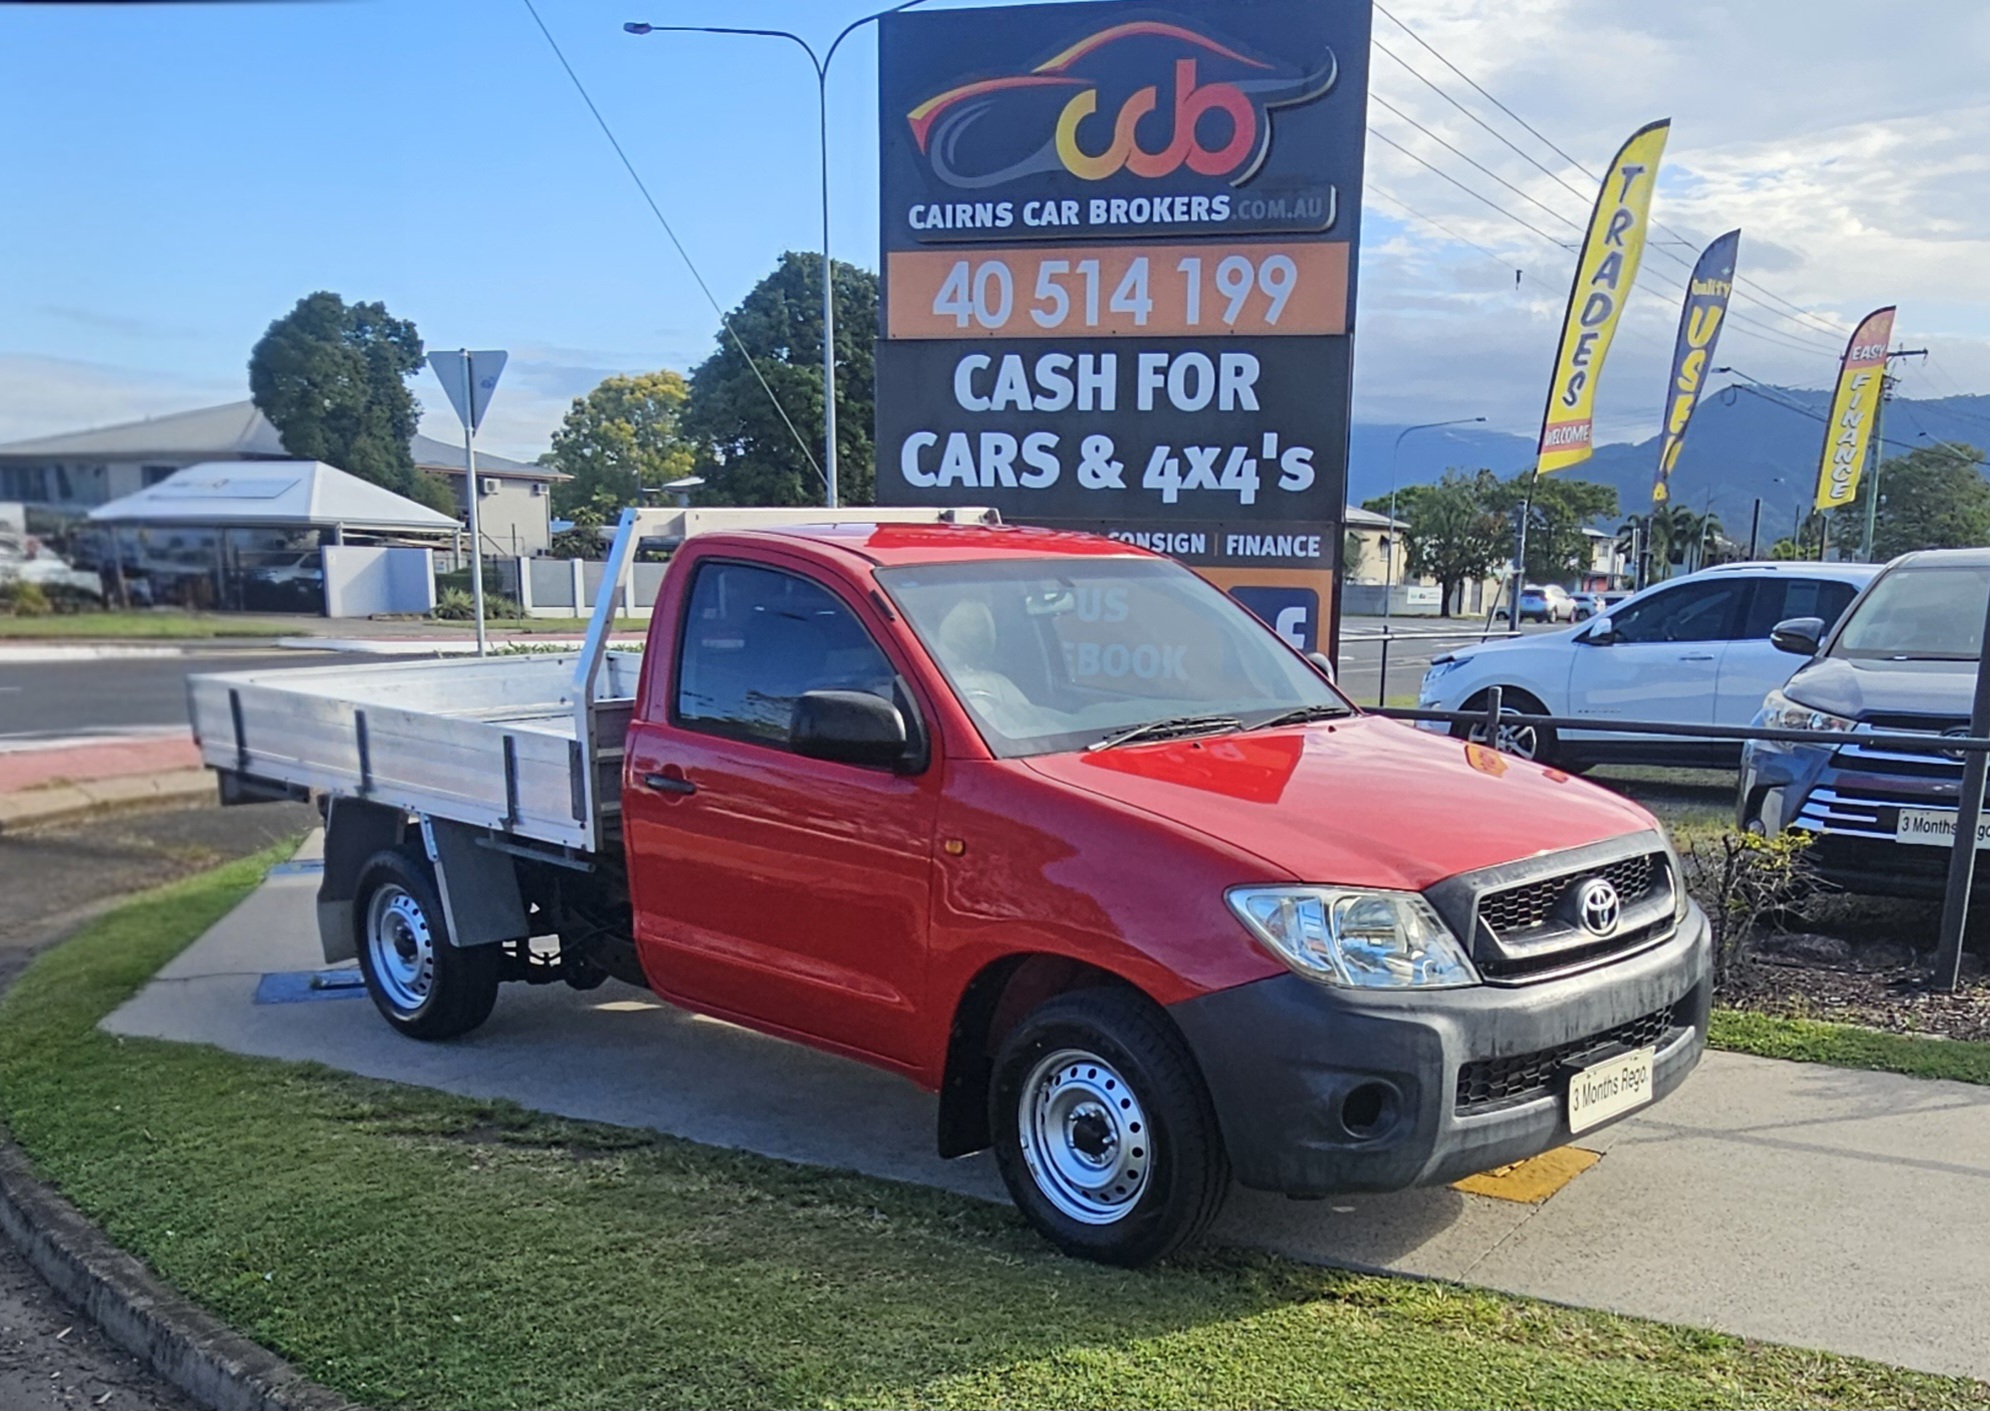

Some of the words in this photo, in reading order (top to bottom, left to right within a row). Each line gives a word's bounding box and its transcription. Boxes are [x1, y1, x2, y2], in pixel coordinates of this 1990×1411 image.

[908, 200, 1013, 230] CAIRNS
[1022, 198, 1080, 228] CAR
[932, 259, 1013, 329] 40
[1029, 257, 1153, 328] 514
[1176, 254, 1298, 326] 199
[1562, 165, 1645, 407] TRADES
[1851, 344, 1886, 362] EASY
[953, 353, 1117, 412] CASH
[1137, 352, 1260, 411] FOR
[1544, 425, 1590, 447] WELCOME
[1829, 372, 1871, 499] FINANCE
[900, 431, 1061, 490] CARS
[1076, 434, 1127, 490] &
[1226, 534, 1321, 557] FINANCE
[1077, 587, 1129, 622] US
[1901, 816, 1910, 832] 3
[1912, 817, 1957, 835] Months
[1573, 1088, 1579, 1112] 3
[1582, 1075, 1619, 1108] Months
